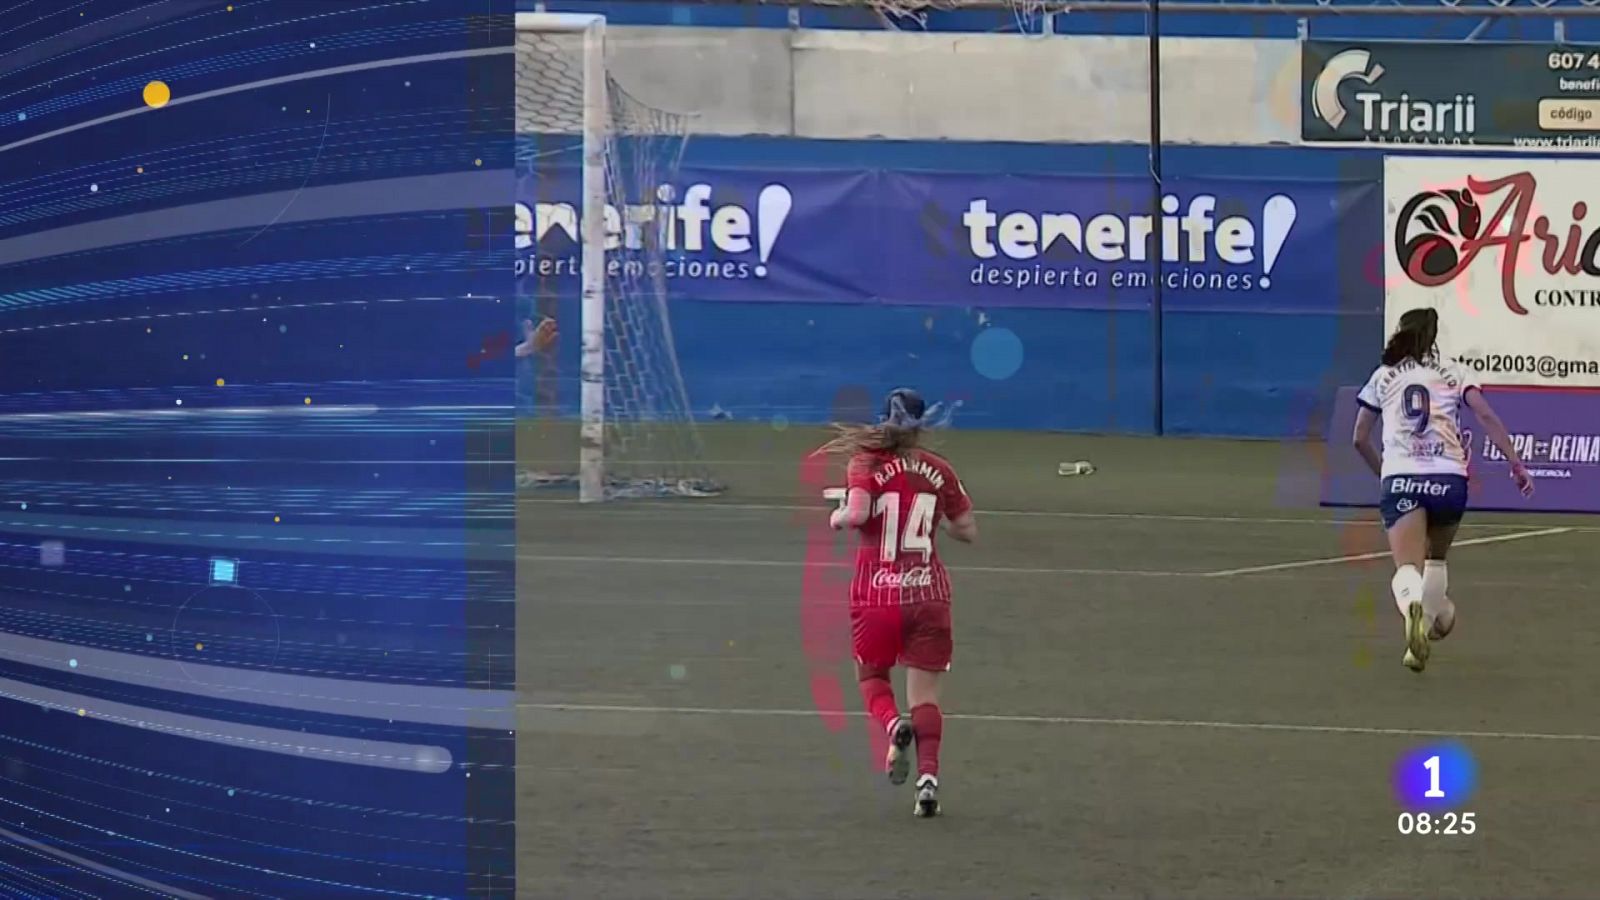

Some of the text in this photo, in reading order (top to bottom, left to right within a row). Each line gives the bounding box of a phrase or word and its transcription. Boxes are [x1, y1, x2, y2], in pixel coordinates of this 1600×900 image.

[1548, 52, 1584, 69] 607
[1356, 93, 1475, 133] Triarii
[1550, 107, 1592, 122] código
[963, 194, 1297, 289] tenerife!
[970, 264, 1253, 290] despierta emciones
[1404, 384, 1430, 434] 9
[1550, 435, 1600, 462] REINA
[873, 492, 937, 564] 14
